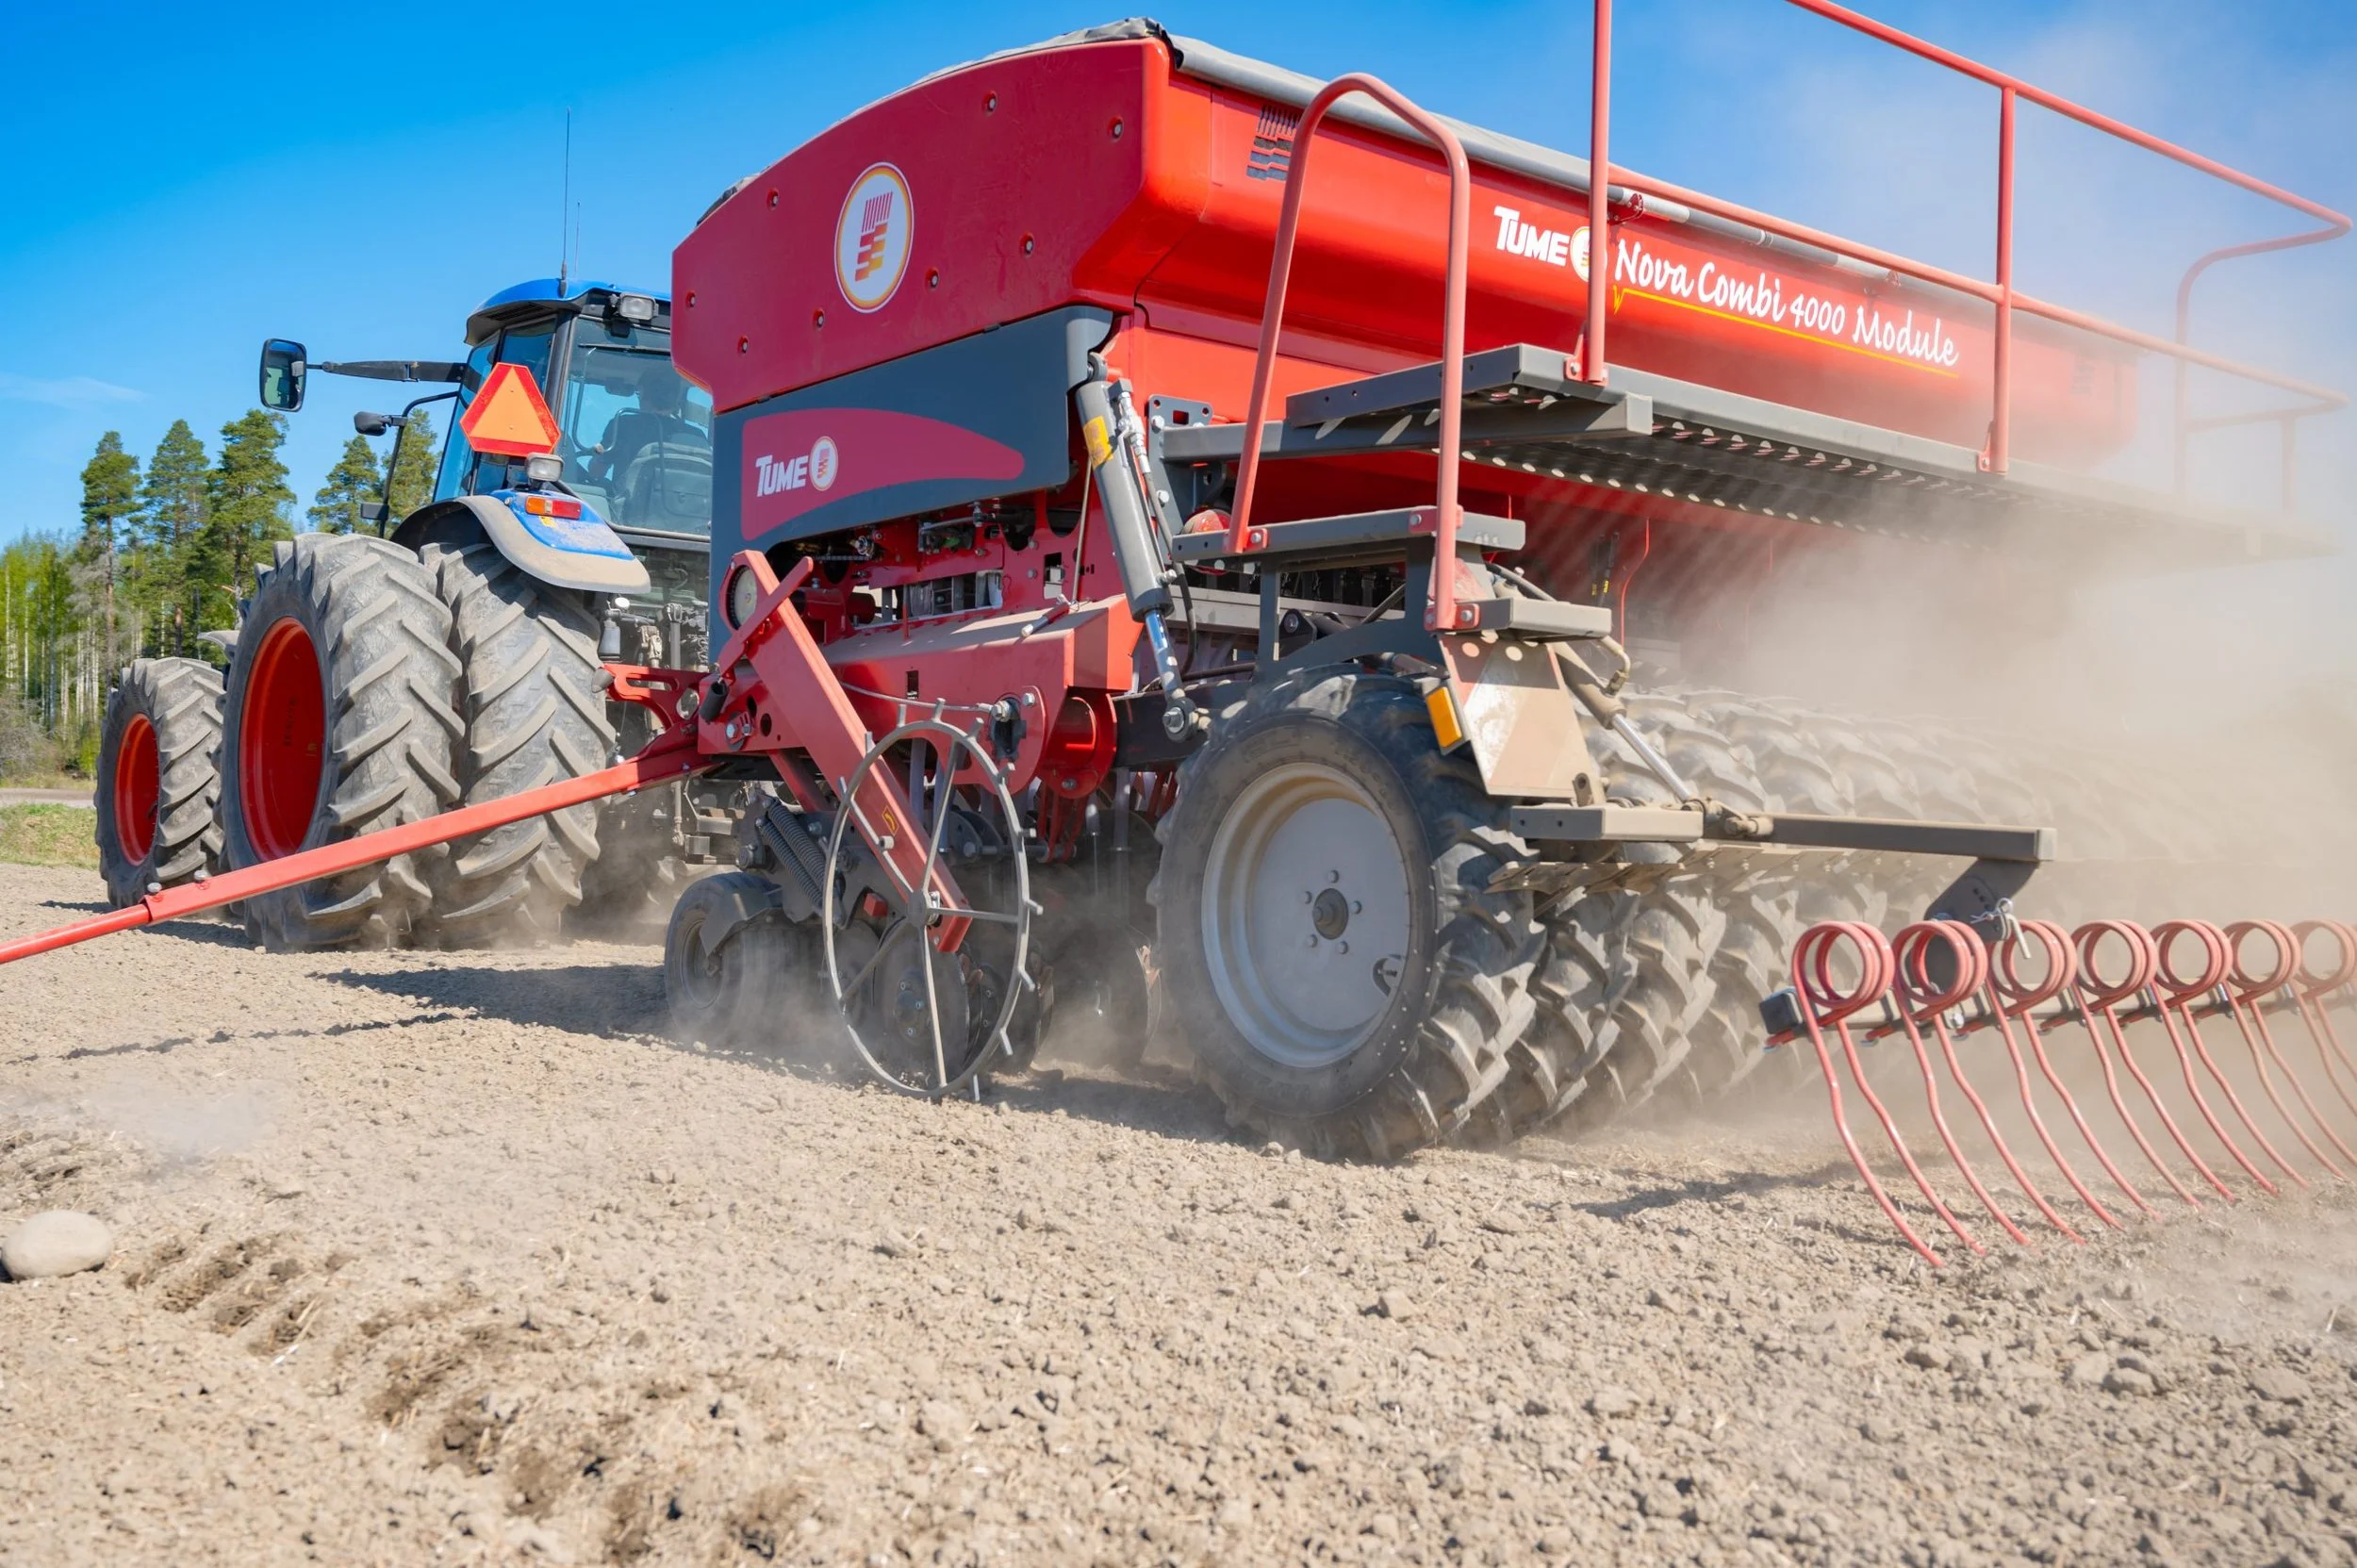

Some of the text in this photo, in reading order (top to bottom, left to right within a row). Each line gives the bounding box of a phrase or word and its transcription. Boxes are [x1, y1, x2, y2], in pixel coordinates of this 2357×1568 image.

[1494, 206, 1958, 367] TUME Nova Combi 4000 Module
[755, 454, 809, 497] TUME
